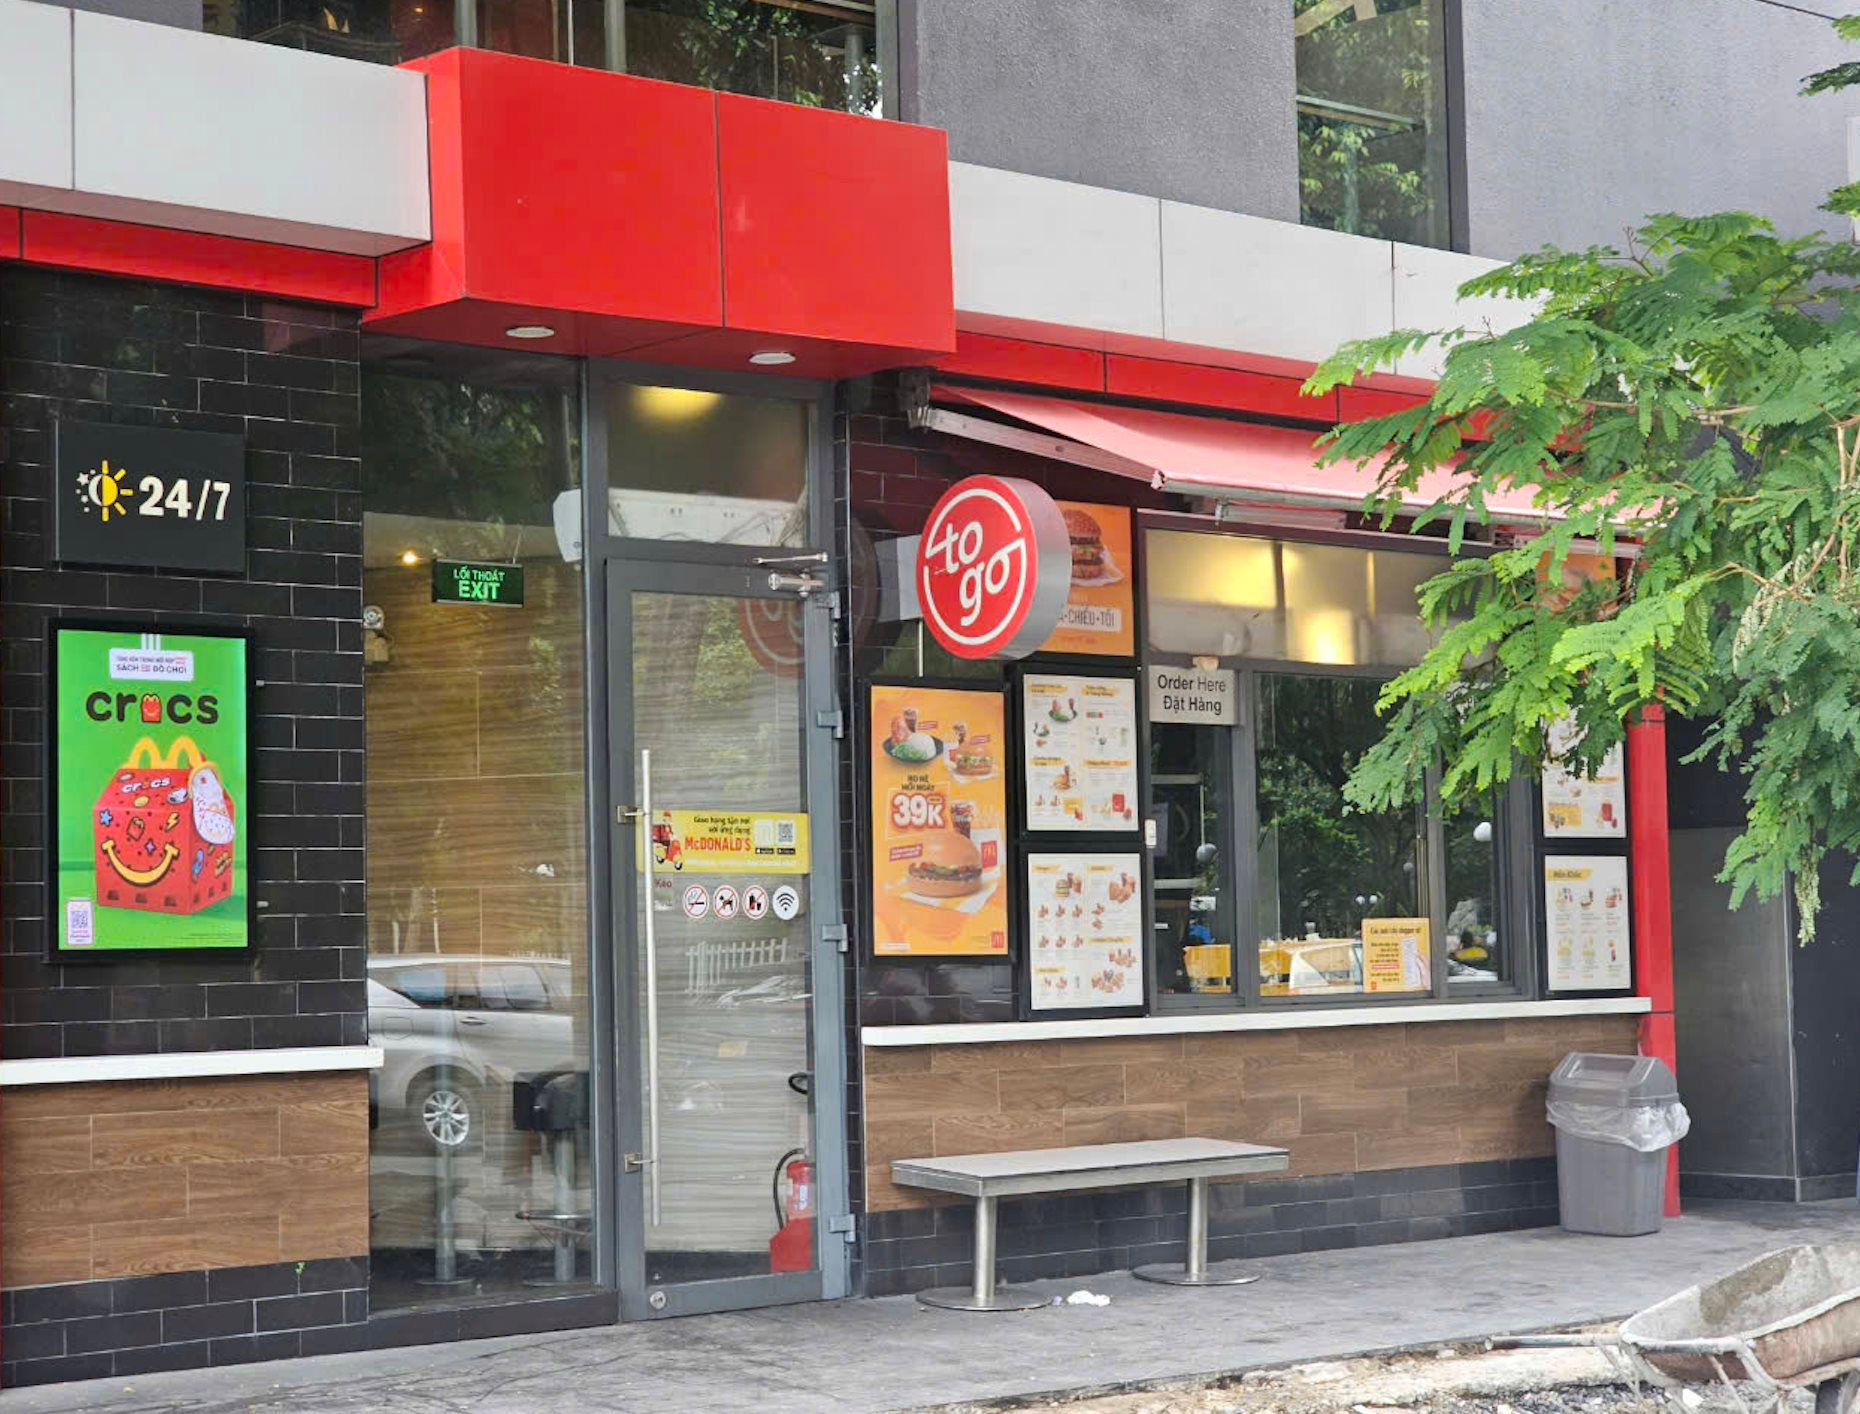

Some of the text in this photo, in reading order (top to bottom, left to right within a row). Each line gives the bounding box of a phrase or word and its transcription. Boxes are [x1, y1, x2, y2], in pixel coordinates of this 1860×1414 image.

[138, 474, 231, 521] 24/7
[938, 521, 984, 573] to
[458, 580, 501, 600] EXIT
[958, 547, 1011, 627] go
[1157, 674, 1226, 693] Order Here
[1163, 695, 1222, 716] Đặt Hàng
